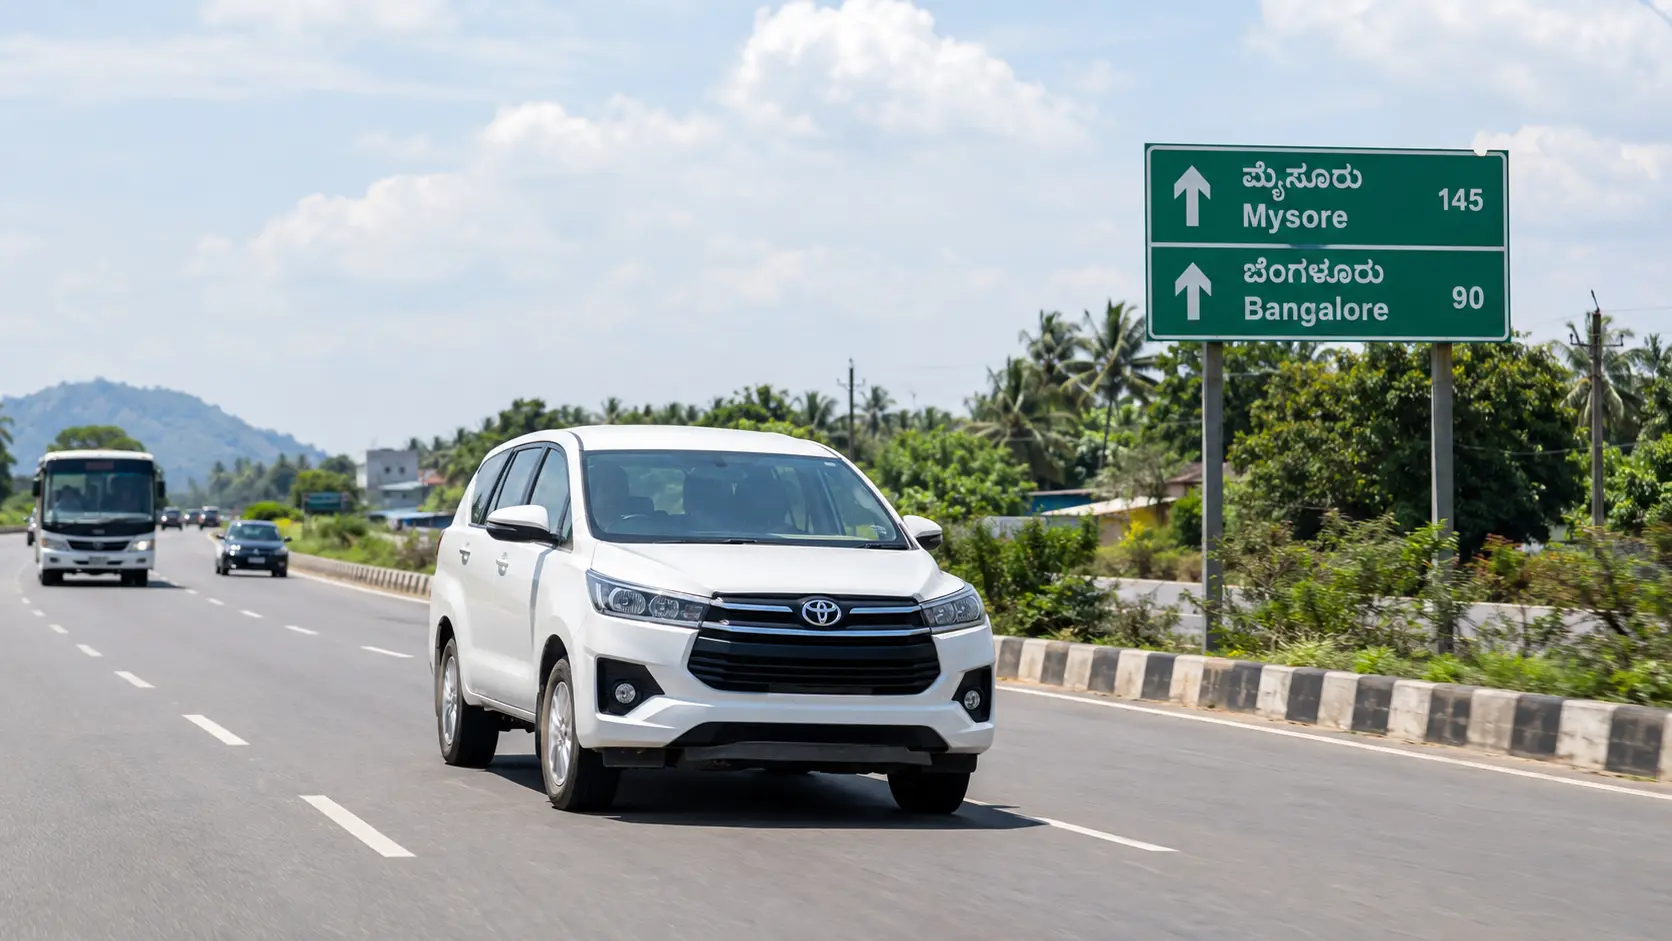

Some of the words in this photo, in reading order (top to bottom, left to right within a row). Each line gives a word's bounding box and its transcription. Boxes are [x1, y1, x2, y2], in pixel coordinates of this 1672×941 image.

[1438, 188, 1484, 211] 145
[1243, 203, 1348, 234] Mysore
[1244, 296, 1389, 327] Bangalore
[1452, 286, 1485, 310] 90
